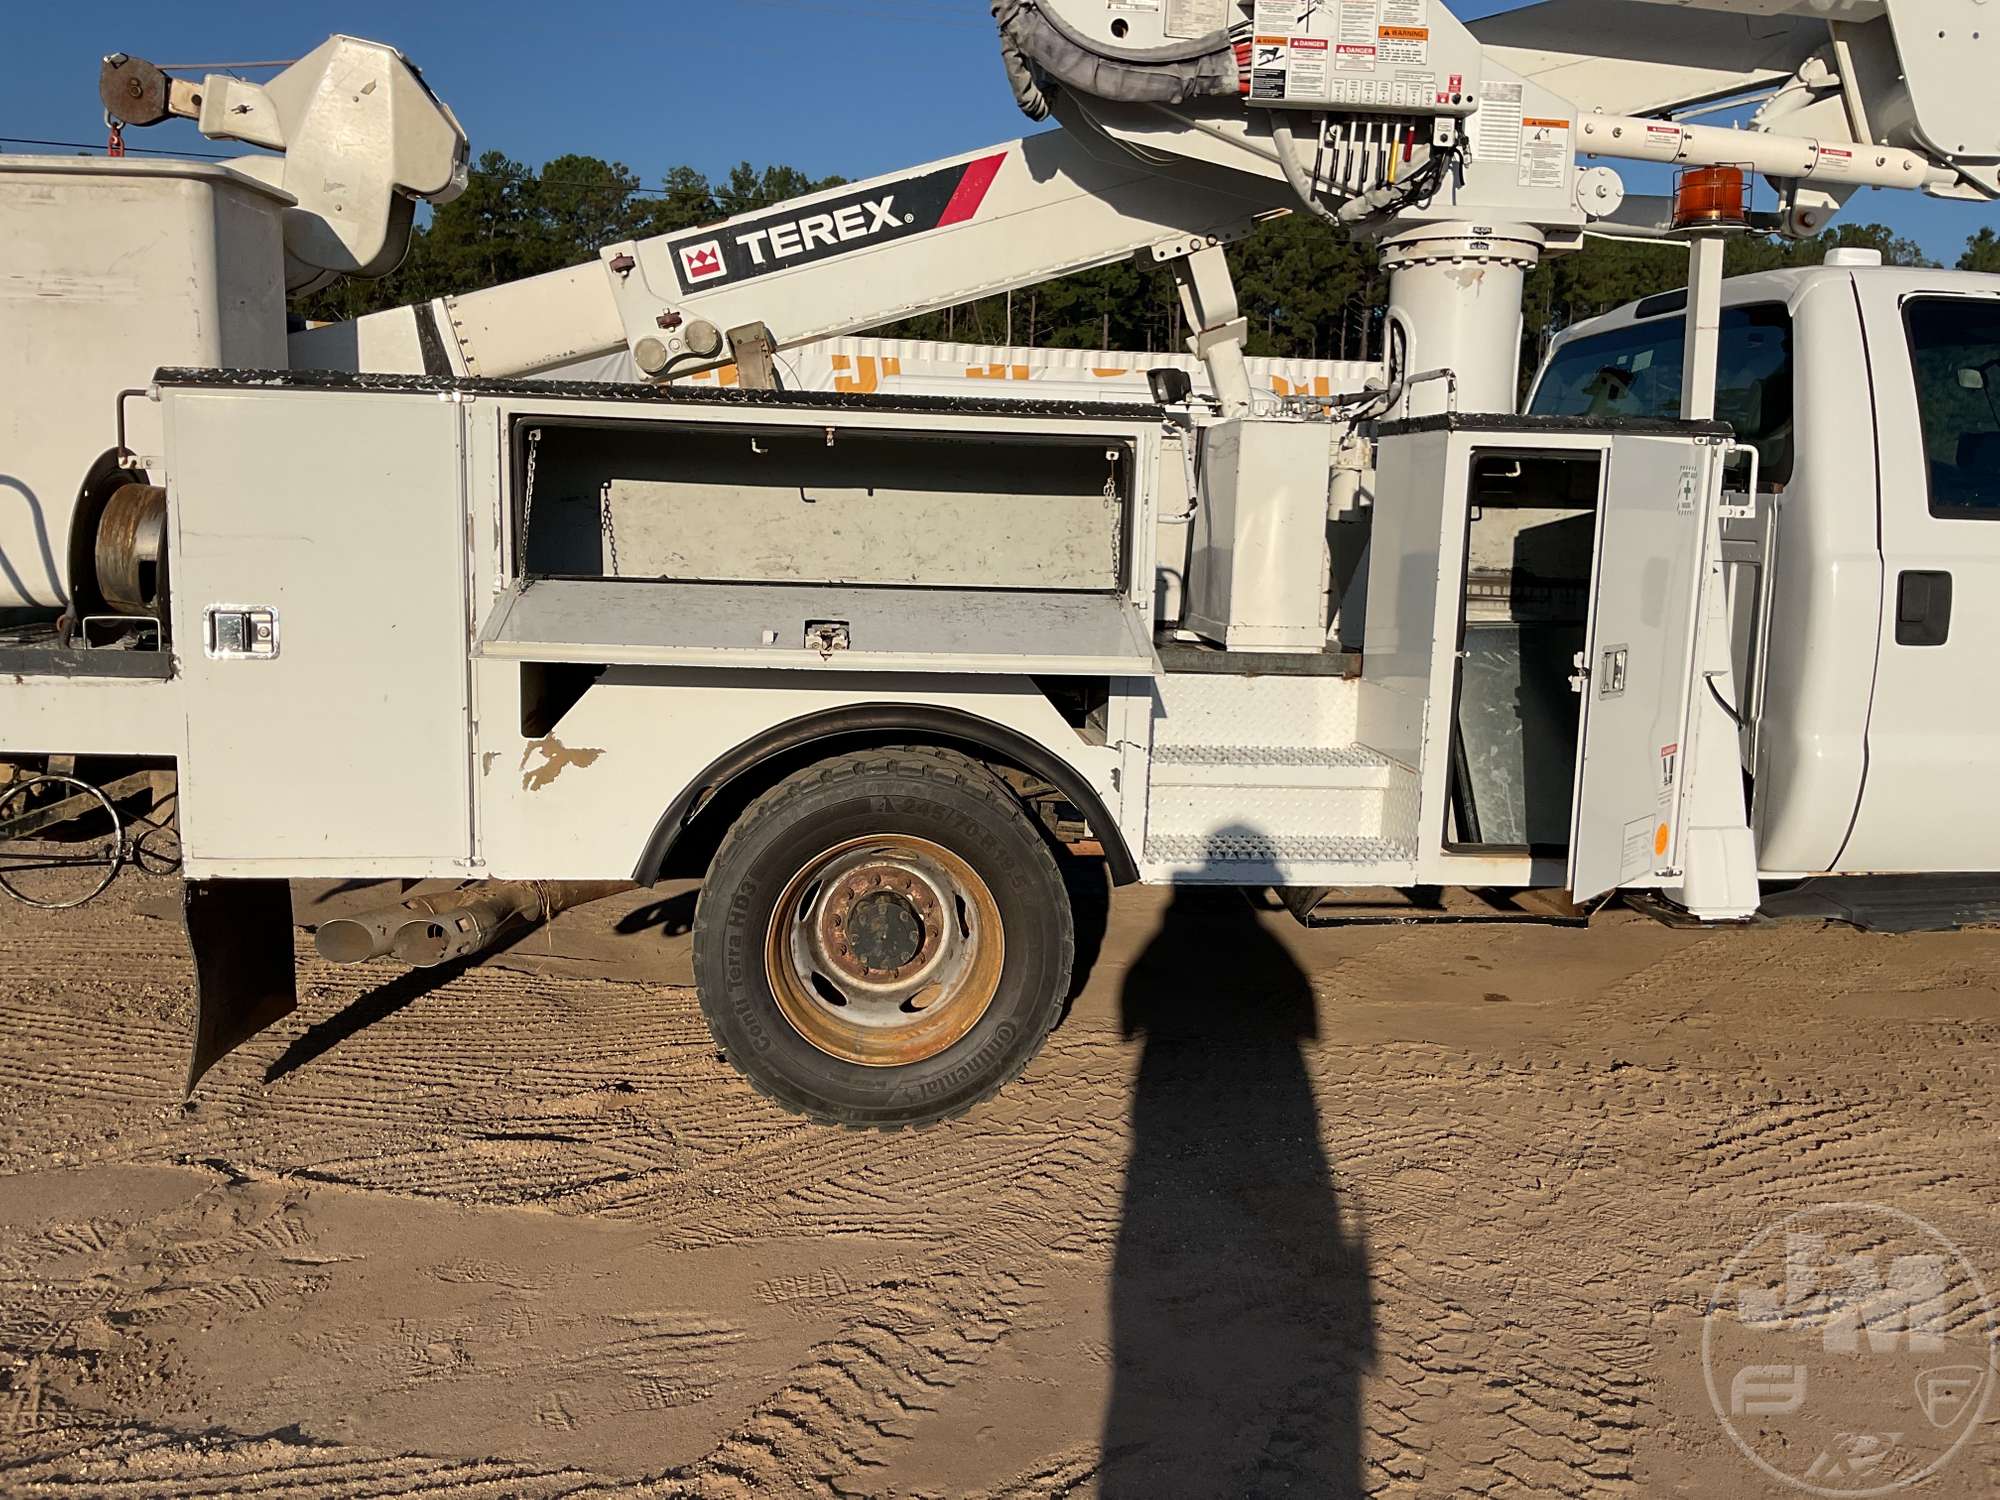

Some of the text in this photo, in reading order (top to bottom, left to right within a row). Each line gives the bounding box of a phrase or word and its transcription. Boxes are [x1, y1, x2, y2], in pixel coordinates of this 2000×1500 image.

[1345, 46, 1374, 55] DANGER
[1391, 30, 1424, 38] WARNING
[735, 195, 903, 264] TEREX
[727, 880, 771, 1052] Conti Terra HD3
[919, 1020, 1017, 1098] Continental
